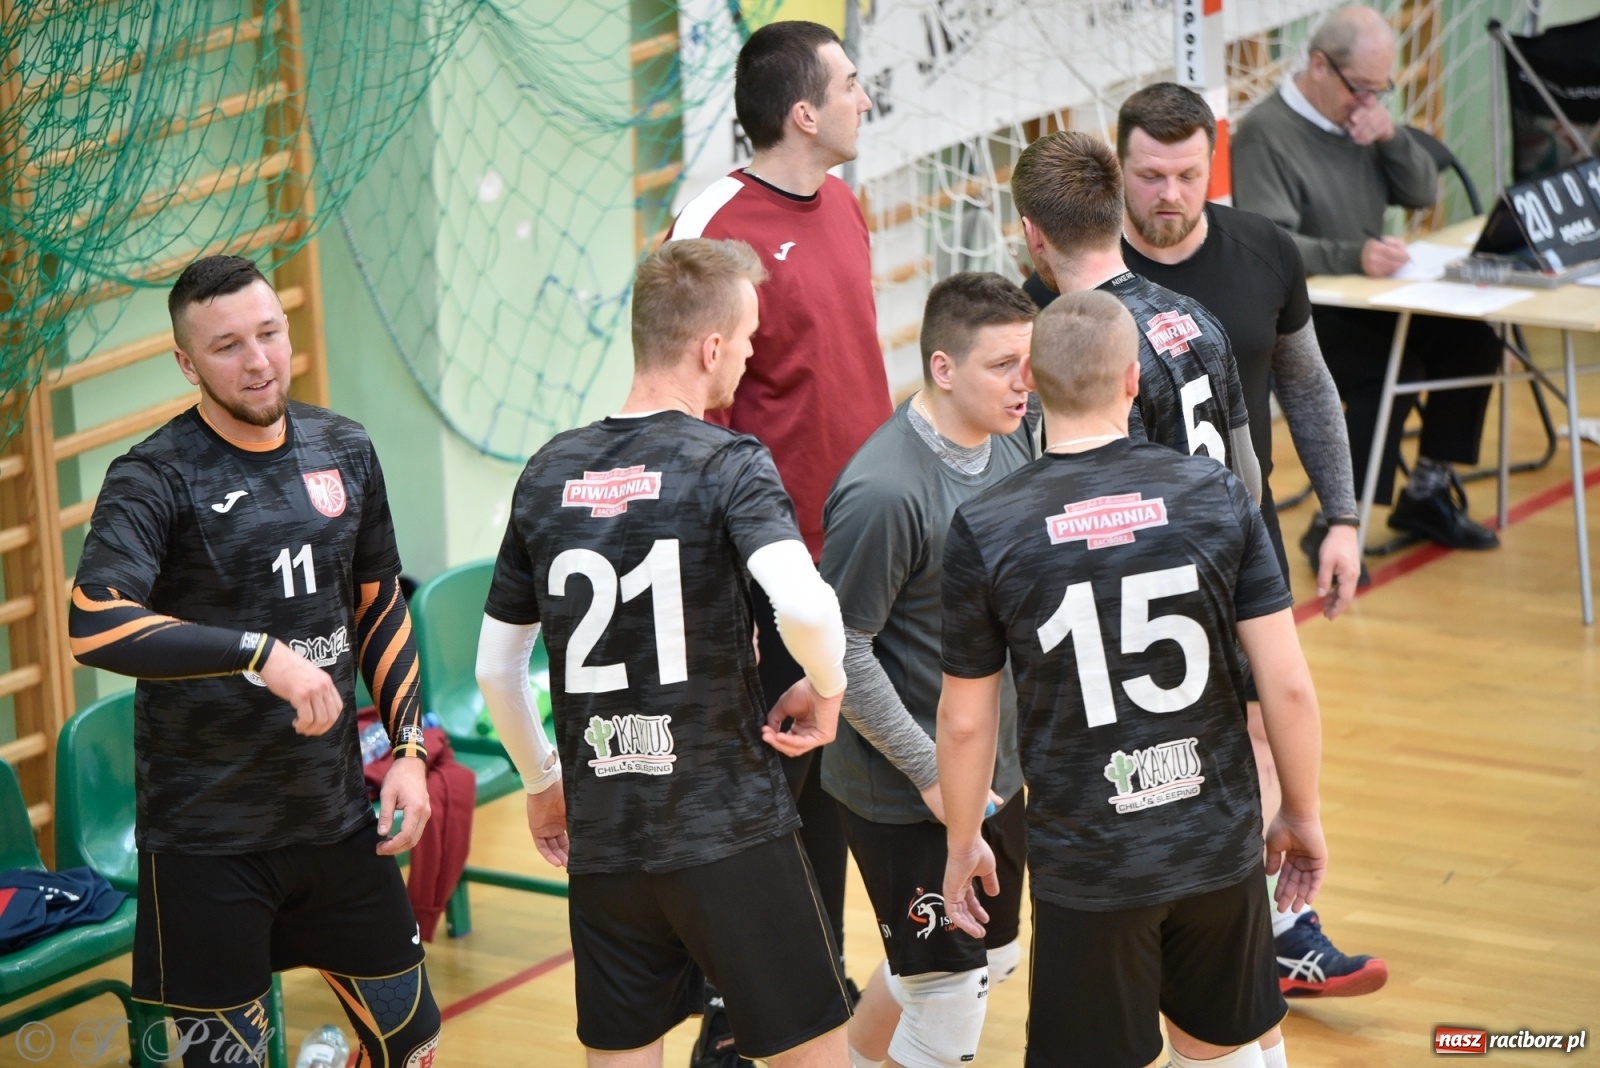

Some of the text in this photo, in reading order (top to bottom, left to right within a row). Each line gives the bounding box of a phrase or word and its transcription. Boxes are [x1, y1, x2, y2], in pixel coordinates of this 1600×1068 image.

[1514, 190, 1554, 243] 20
[1180, 374, 1225, 465] 5
[570, 479, 652, 500] PIWIARNIA
[1056, 507, 1157, 536] PIWIARNIA
[272, 544, 317, 598] 11
[548, 538, 688, 694] 21
[1036, 564, 1210, 728] 15
[614, 717, 671, 753] KAKTUS
[597, 764, 625, 775] CHILL
[1136, 740, 1198, 787] KAKTUS
[1118, 798, 1145, 812] CHILL
[1156, 786, 1198, 803] SLEEPING
